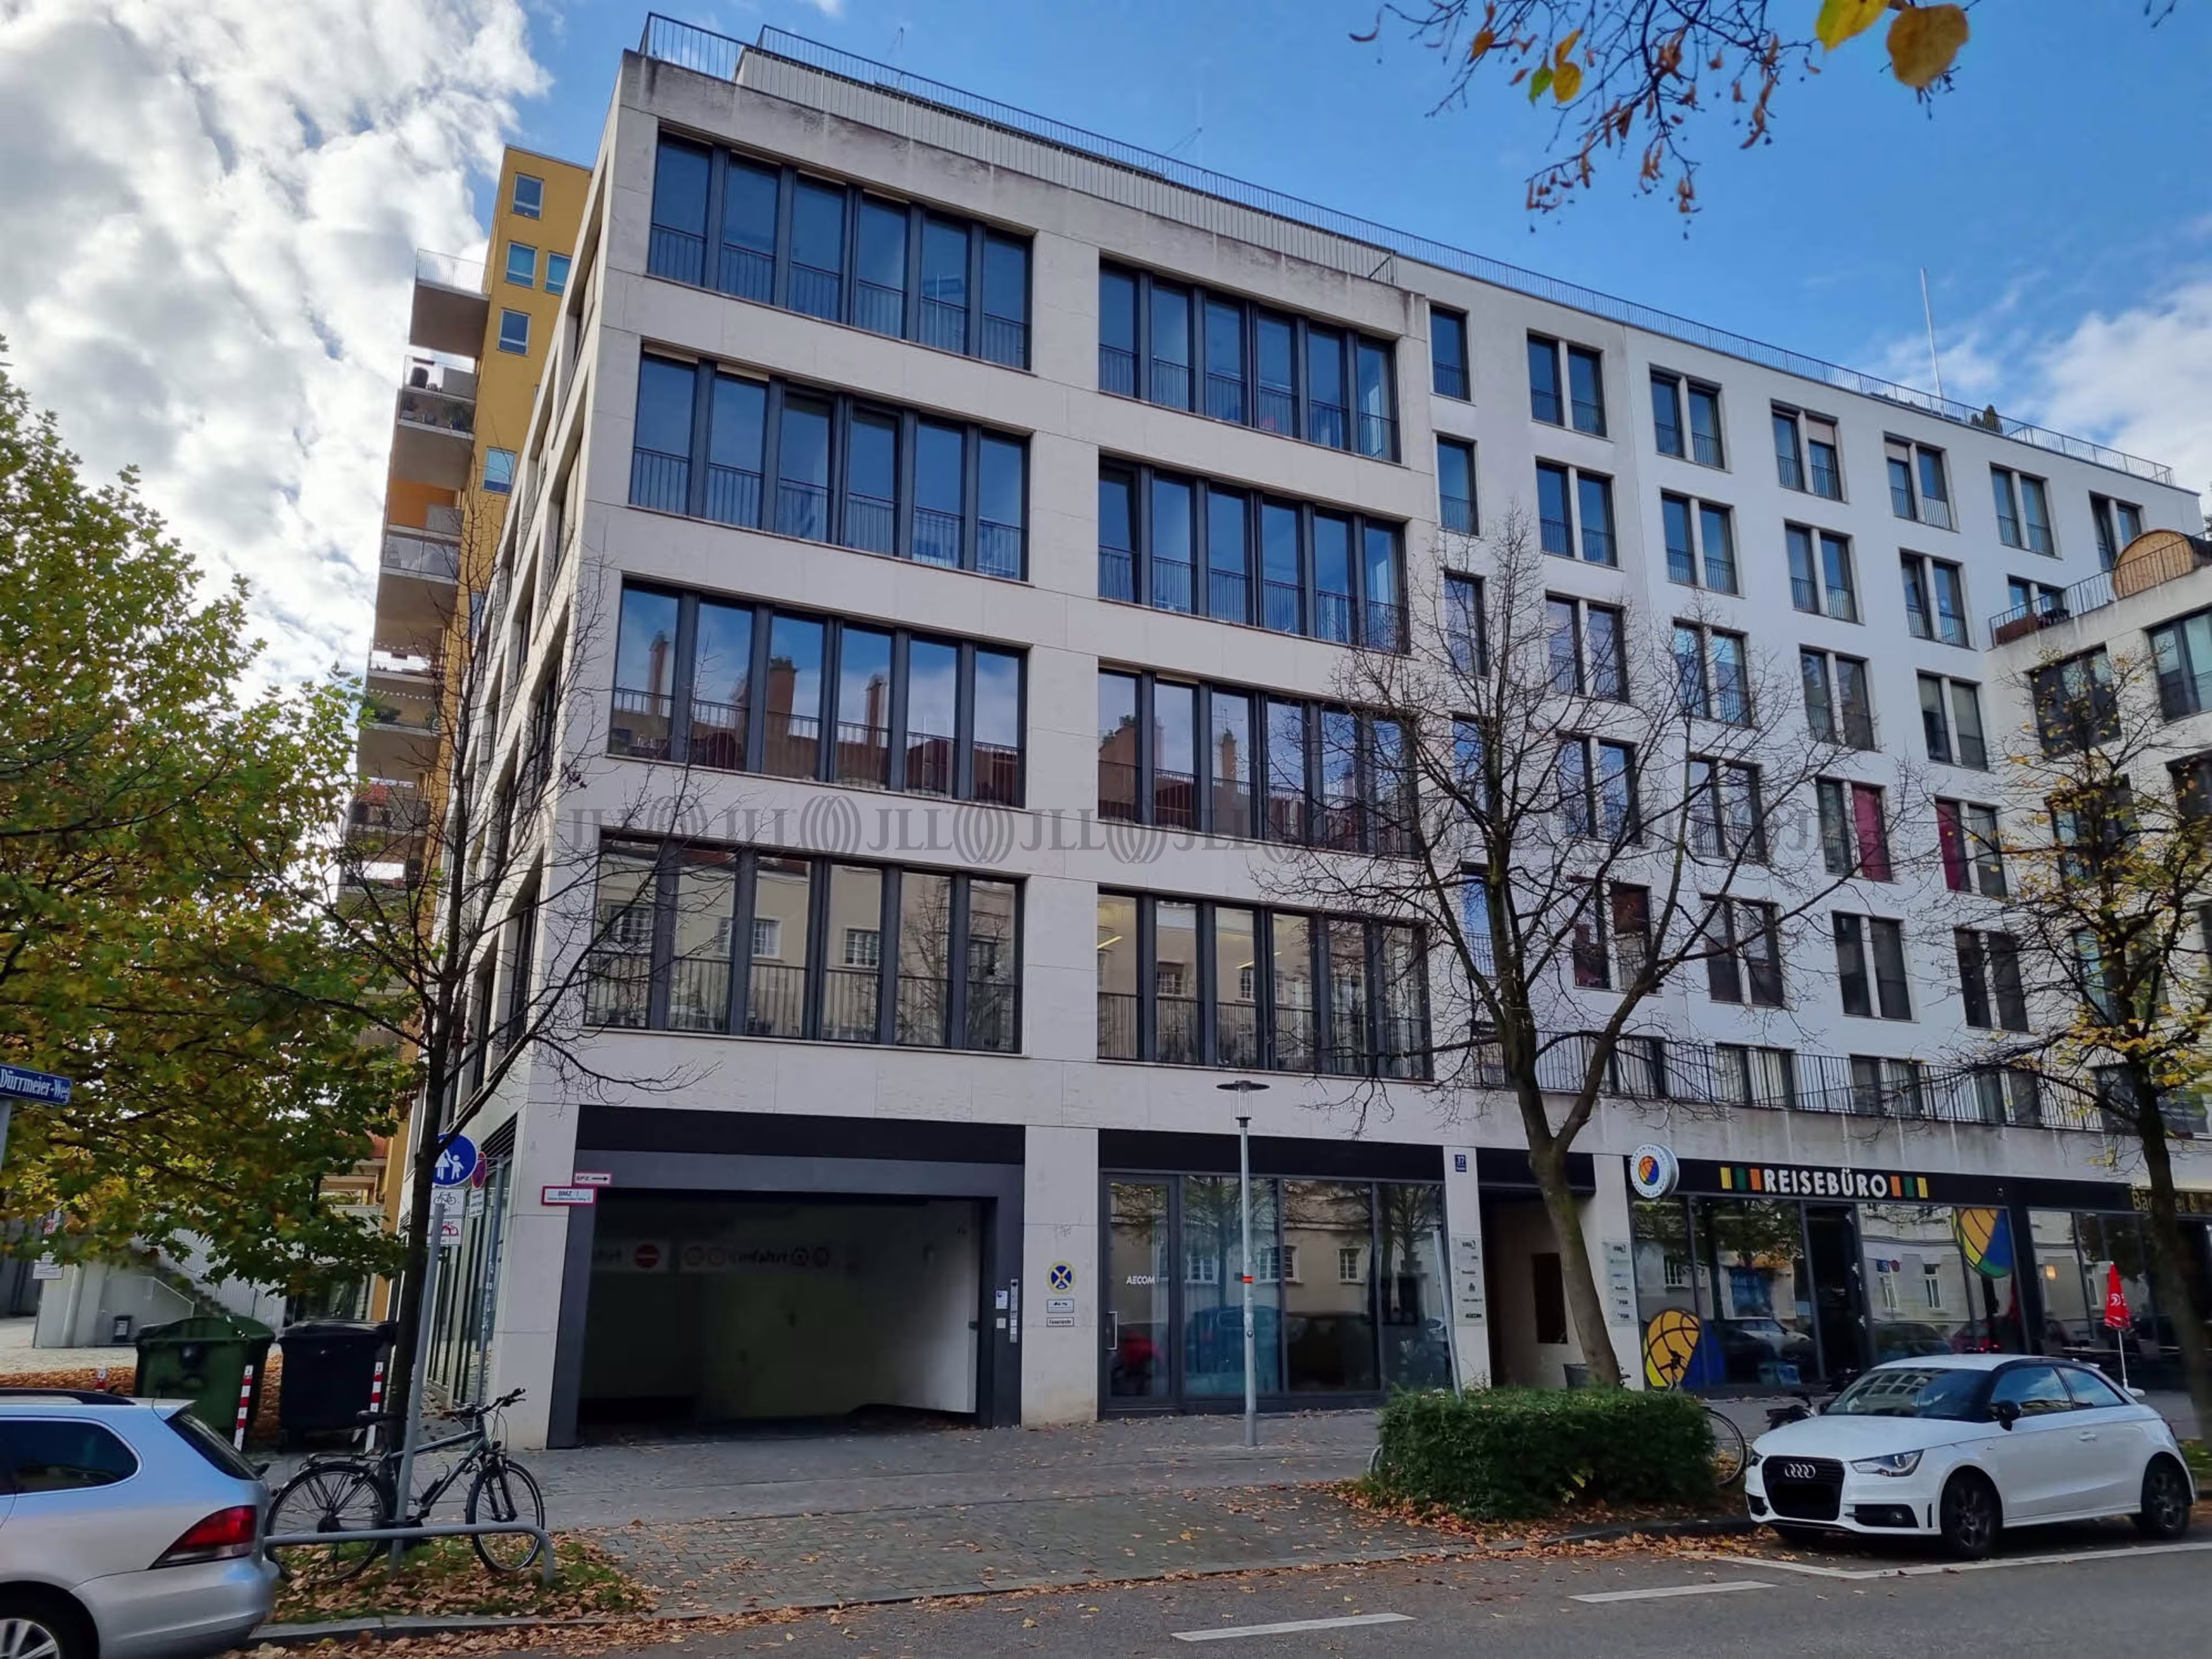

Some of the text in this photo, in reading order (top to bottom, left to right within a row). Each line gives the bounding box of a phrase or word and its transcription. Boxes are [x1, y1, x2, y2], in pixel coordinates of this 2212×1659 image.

[1457, 1156, 1465, 1164] 37
[1764, 1168, 1887, 1198] REISEBÜRO
[1126, 1275, 1156, 1285] AECOM
